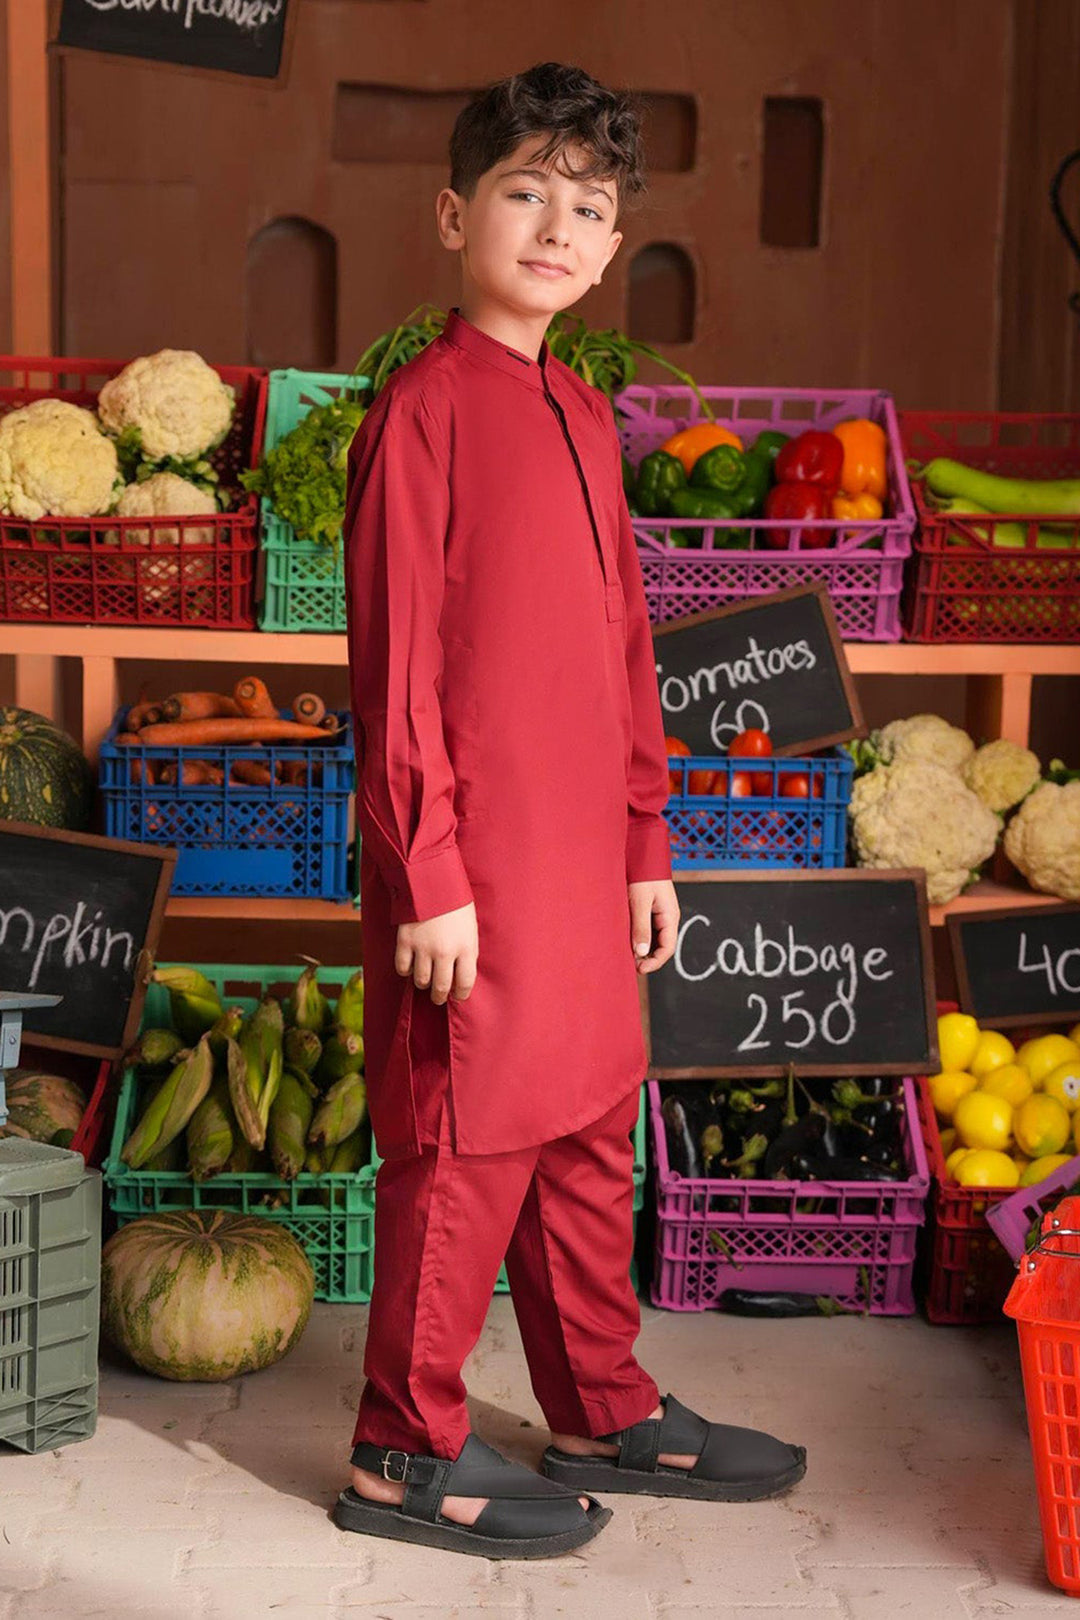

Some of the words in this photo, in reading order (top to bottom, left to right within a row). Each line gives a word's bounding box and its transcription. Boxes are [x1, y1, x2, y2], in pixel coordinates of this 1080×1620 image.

[655, 636, 816, 712] omatoes
[710, 699, 770, 750] 60
[674, 914, 893, 1003] Cabbage
[737, 990, 856, 1051] 250
